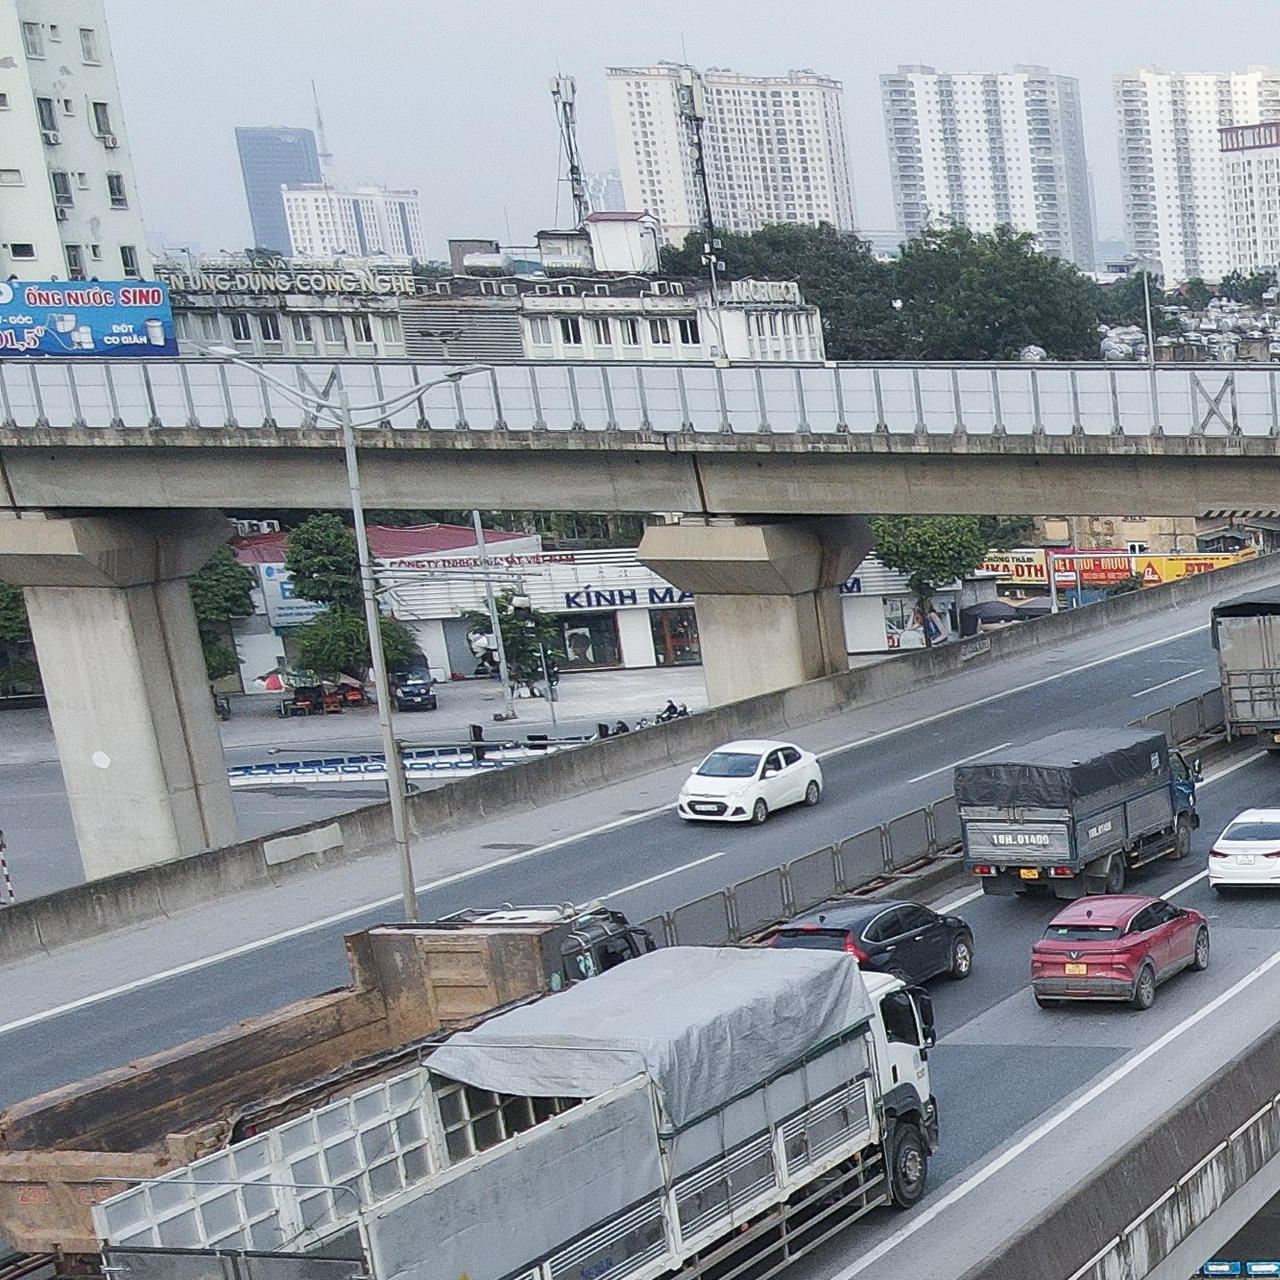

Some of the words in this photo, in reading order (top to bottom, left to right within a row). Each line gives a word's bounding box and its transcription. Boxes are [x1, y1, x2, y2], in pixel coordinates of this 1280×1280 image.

[26, 285, 63, 306] ỐNG
[66, 286, 114, 306] NƯỚC
[120, 287, 163, 306] SINO
[564, 584, 638, 608] KÍNH
